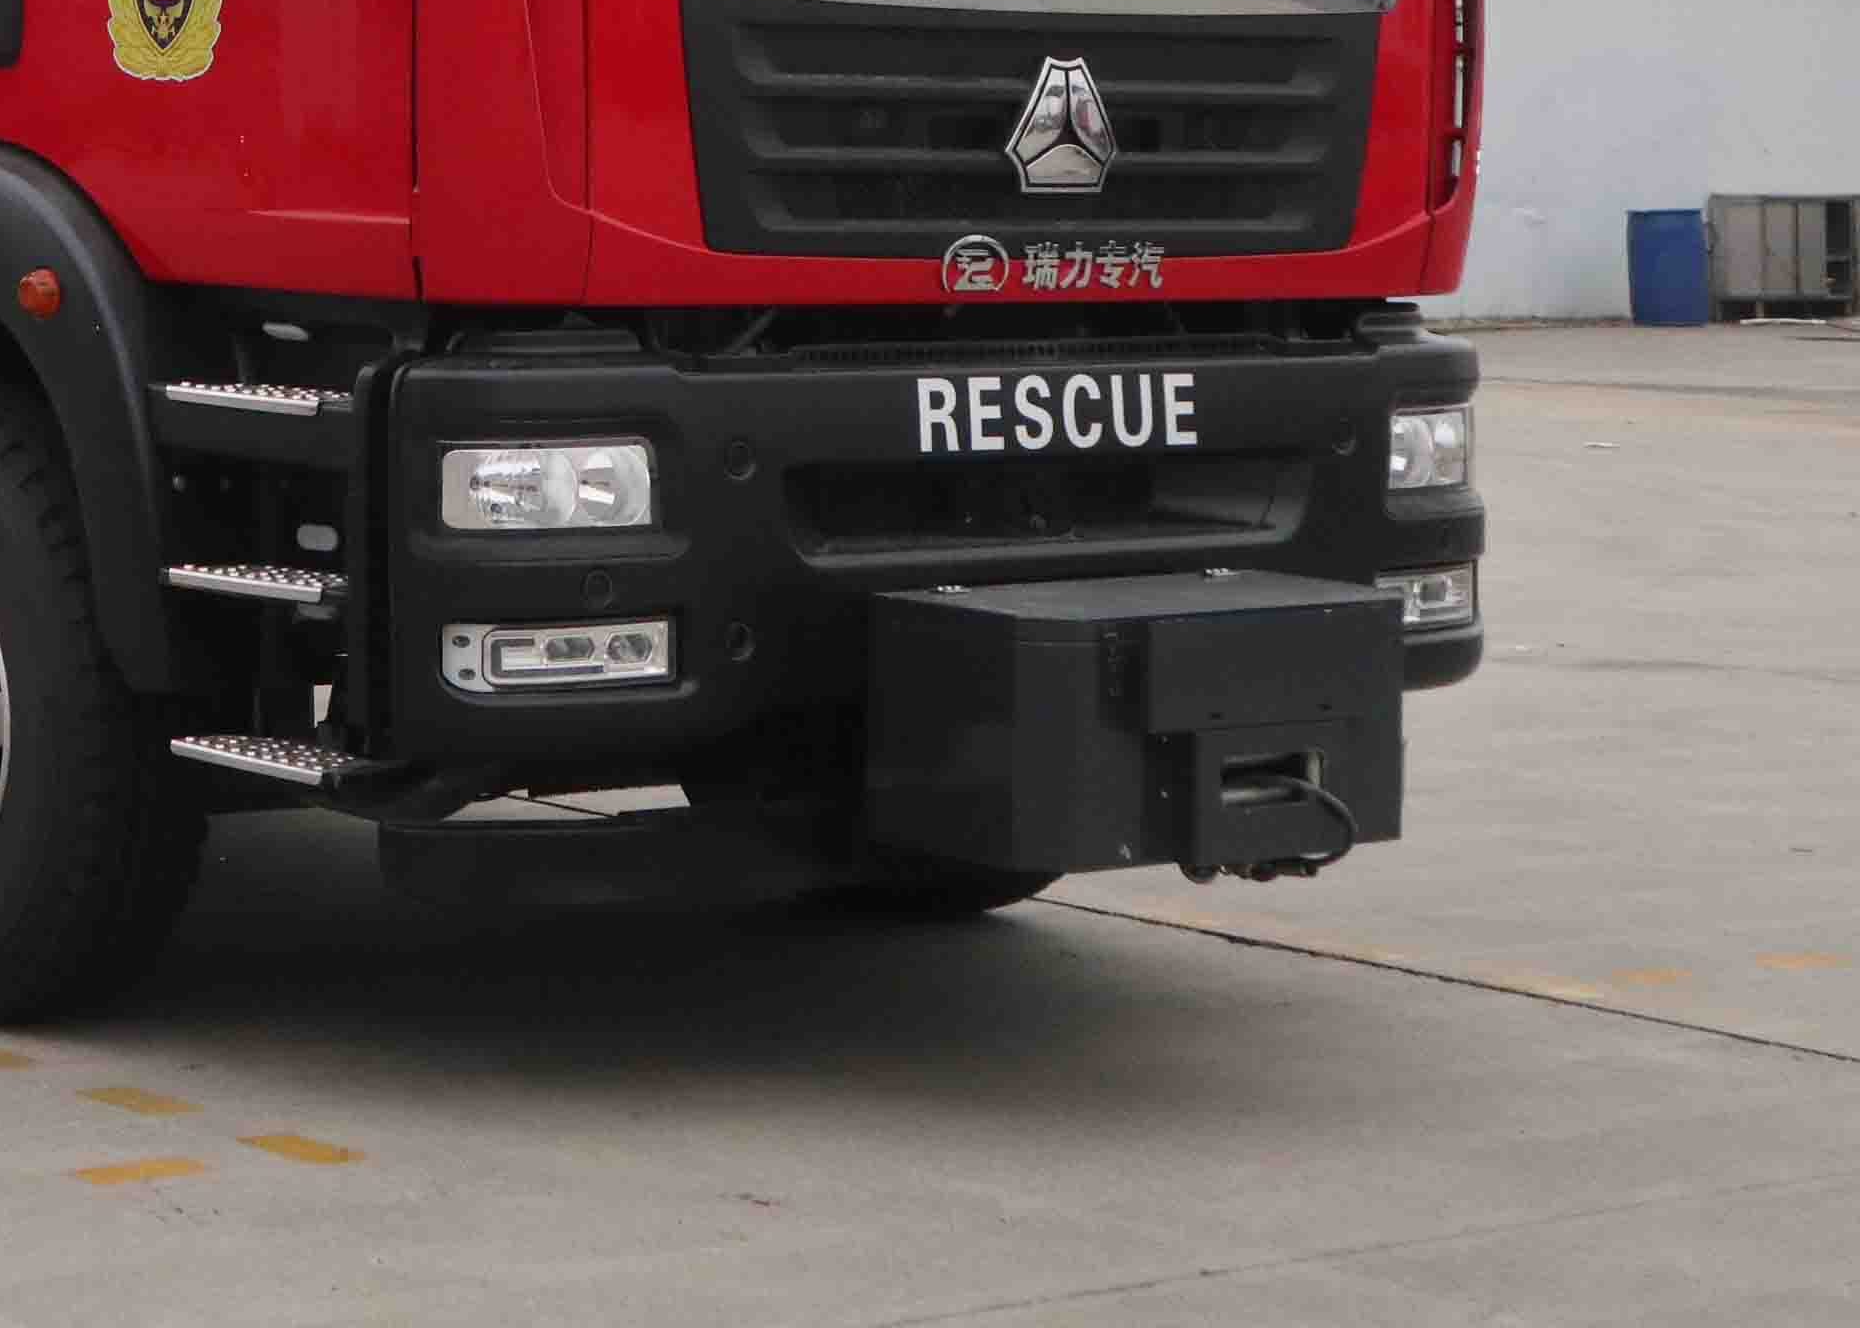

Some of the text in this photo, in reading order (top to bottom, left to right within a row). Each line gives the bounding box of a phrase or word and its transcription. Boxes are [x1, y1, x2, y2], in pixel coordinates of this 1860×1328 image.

[1021, 239, 1165, 291] 瑞力专汽
[916, 373, 1198, 453] RESCUE
